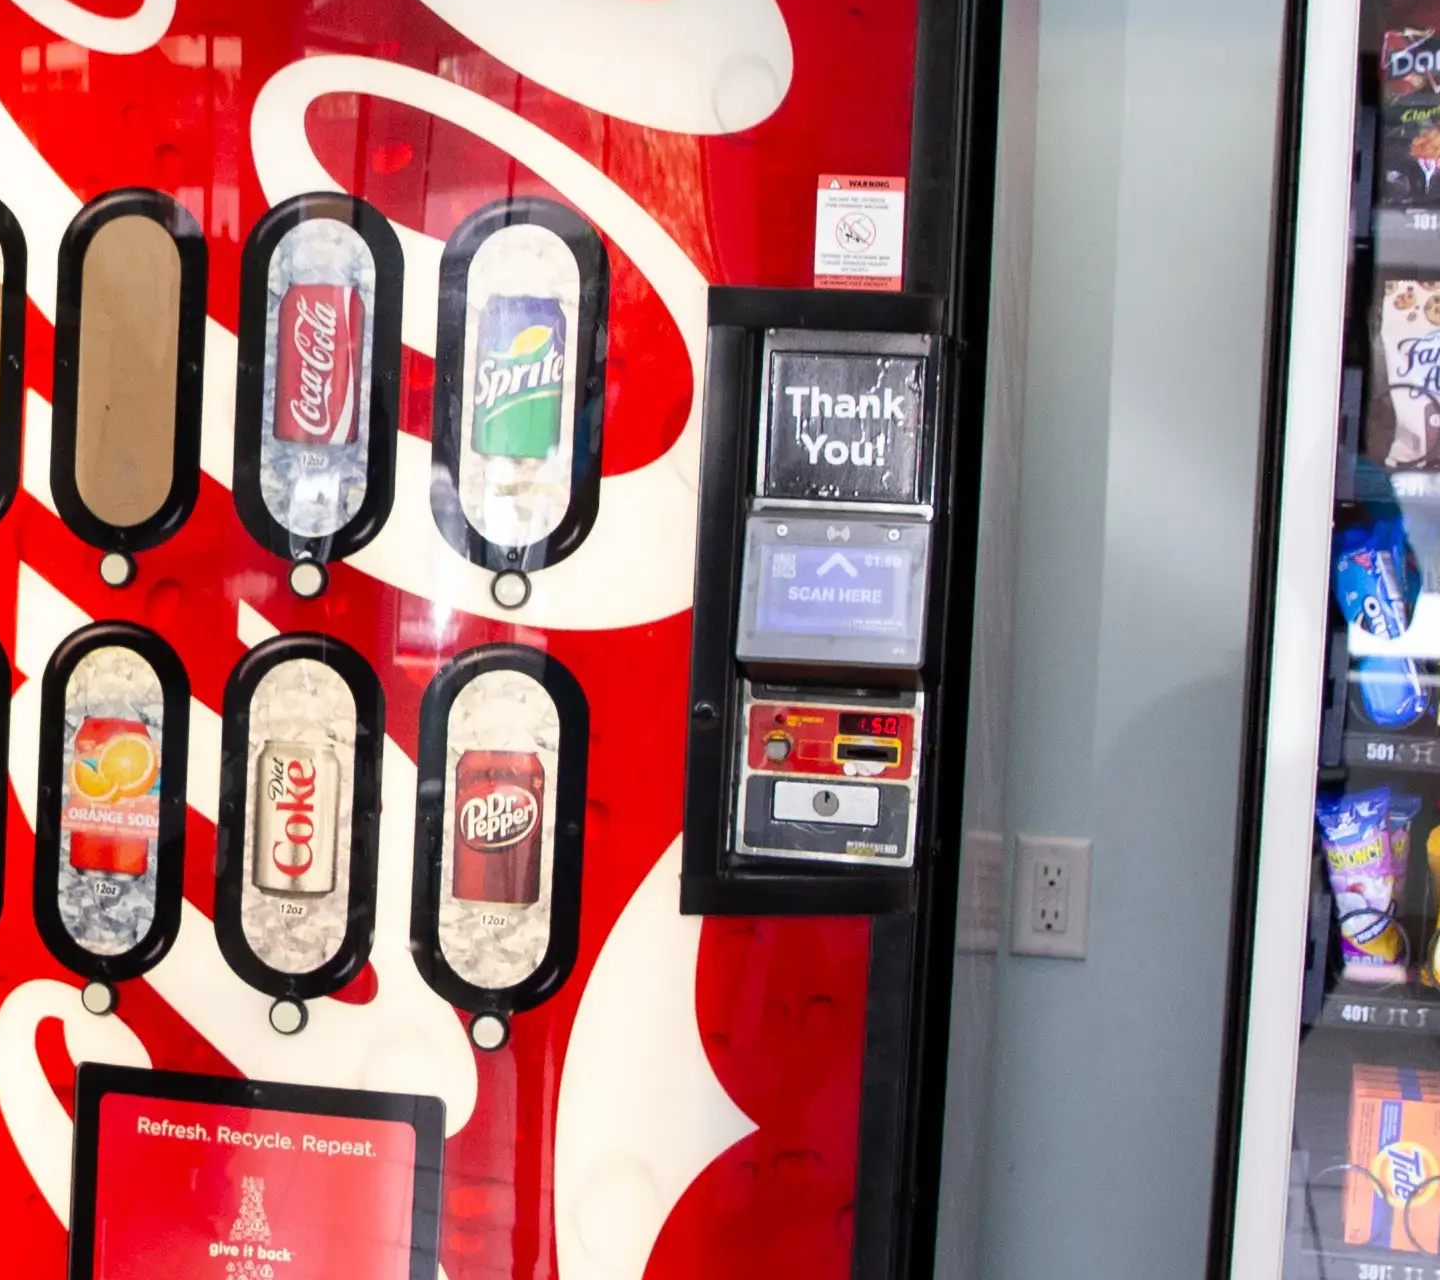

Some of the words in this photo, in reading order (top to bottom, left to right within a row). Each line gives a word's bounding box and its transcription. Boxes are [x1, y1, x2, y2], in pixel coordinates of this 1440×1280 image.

[849, 180, 890, 189] WARNING
[475, 345, 564, 410] Sprite
[785, 386, 905, 420] Thank
[802, 432, 886, 467] You!
[788, 586, 835, 603] SCAN
[839, 588, 883, 605] HERE
[1366, 743, 1395, 760] 501
[268, 757, 285, 801] Diet
[68, 807, 122, 824] ORANGE
[487, 792, 517, 819] Dr
[273, 759, 317, 878] Coke
[467, 797, 533, 841] Pepper
[96, 883, 117, 896] 12oz
[280, 904, 304, 916] 12oz
[482, 914, 505, 926] 12oz
[1342, 1005, 1369, 1023] 401
[137, 1116, 211, 1143] Refresh.
[217, 1126, 295, 1151] Recycle.
[302, 1135, 377, 1158] Repeat.
[1387, 1147, 1424, 1202] Tide
[209, 1241, 240, 1258] give
[243, 1241, 255, 1258] it
[258, 1245, 292, 1262] back
